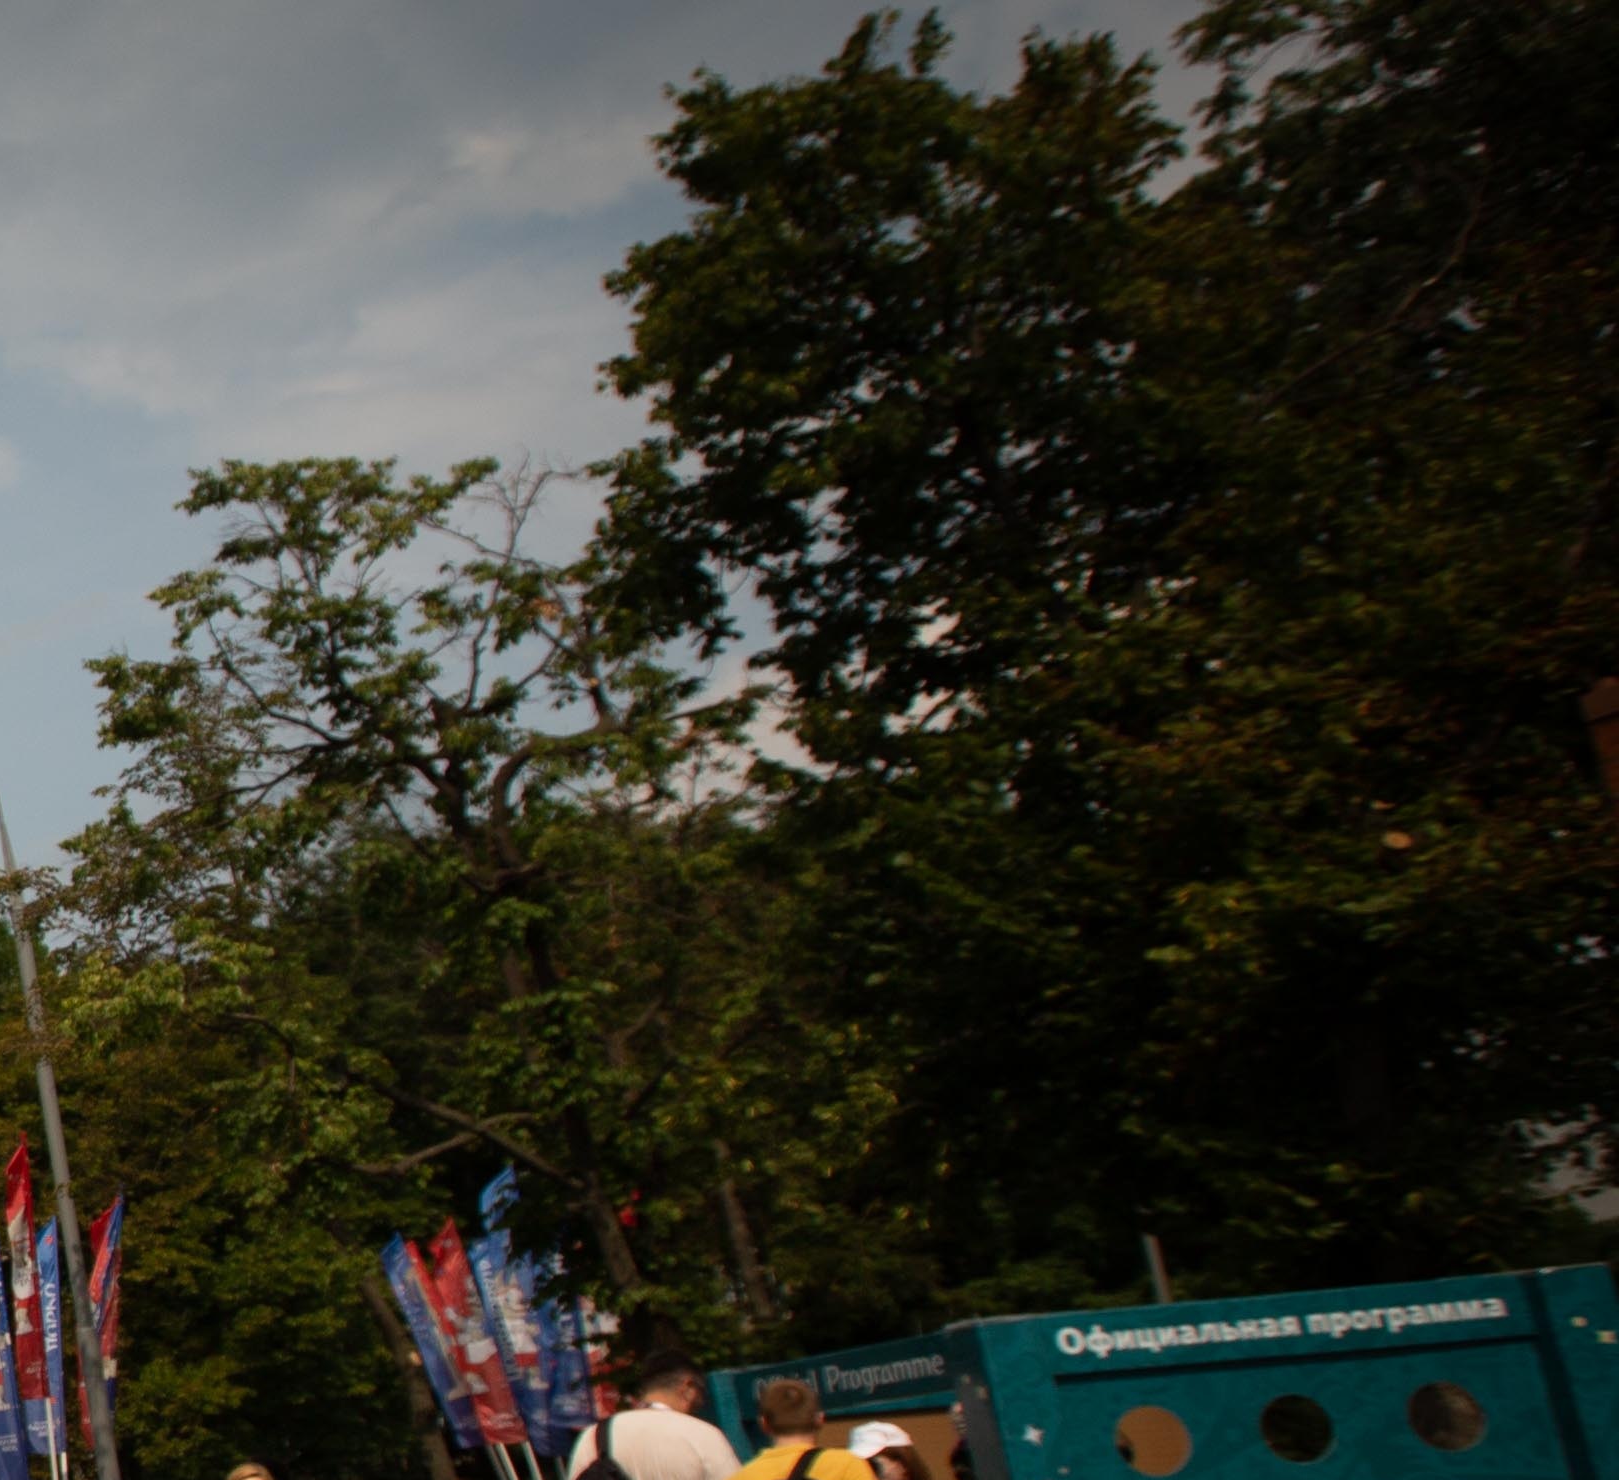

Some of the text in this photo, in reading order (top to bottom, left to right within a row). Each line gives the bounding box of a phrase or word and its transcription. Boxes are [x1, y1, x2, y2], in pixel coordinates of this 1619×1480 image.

[1054, 1294, 1510, 1358] Официальная программа
[825, 1354, 947, 1395] Programme
